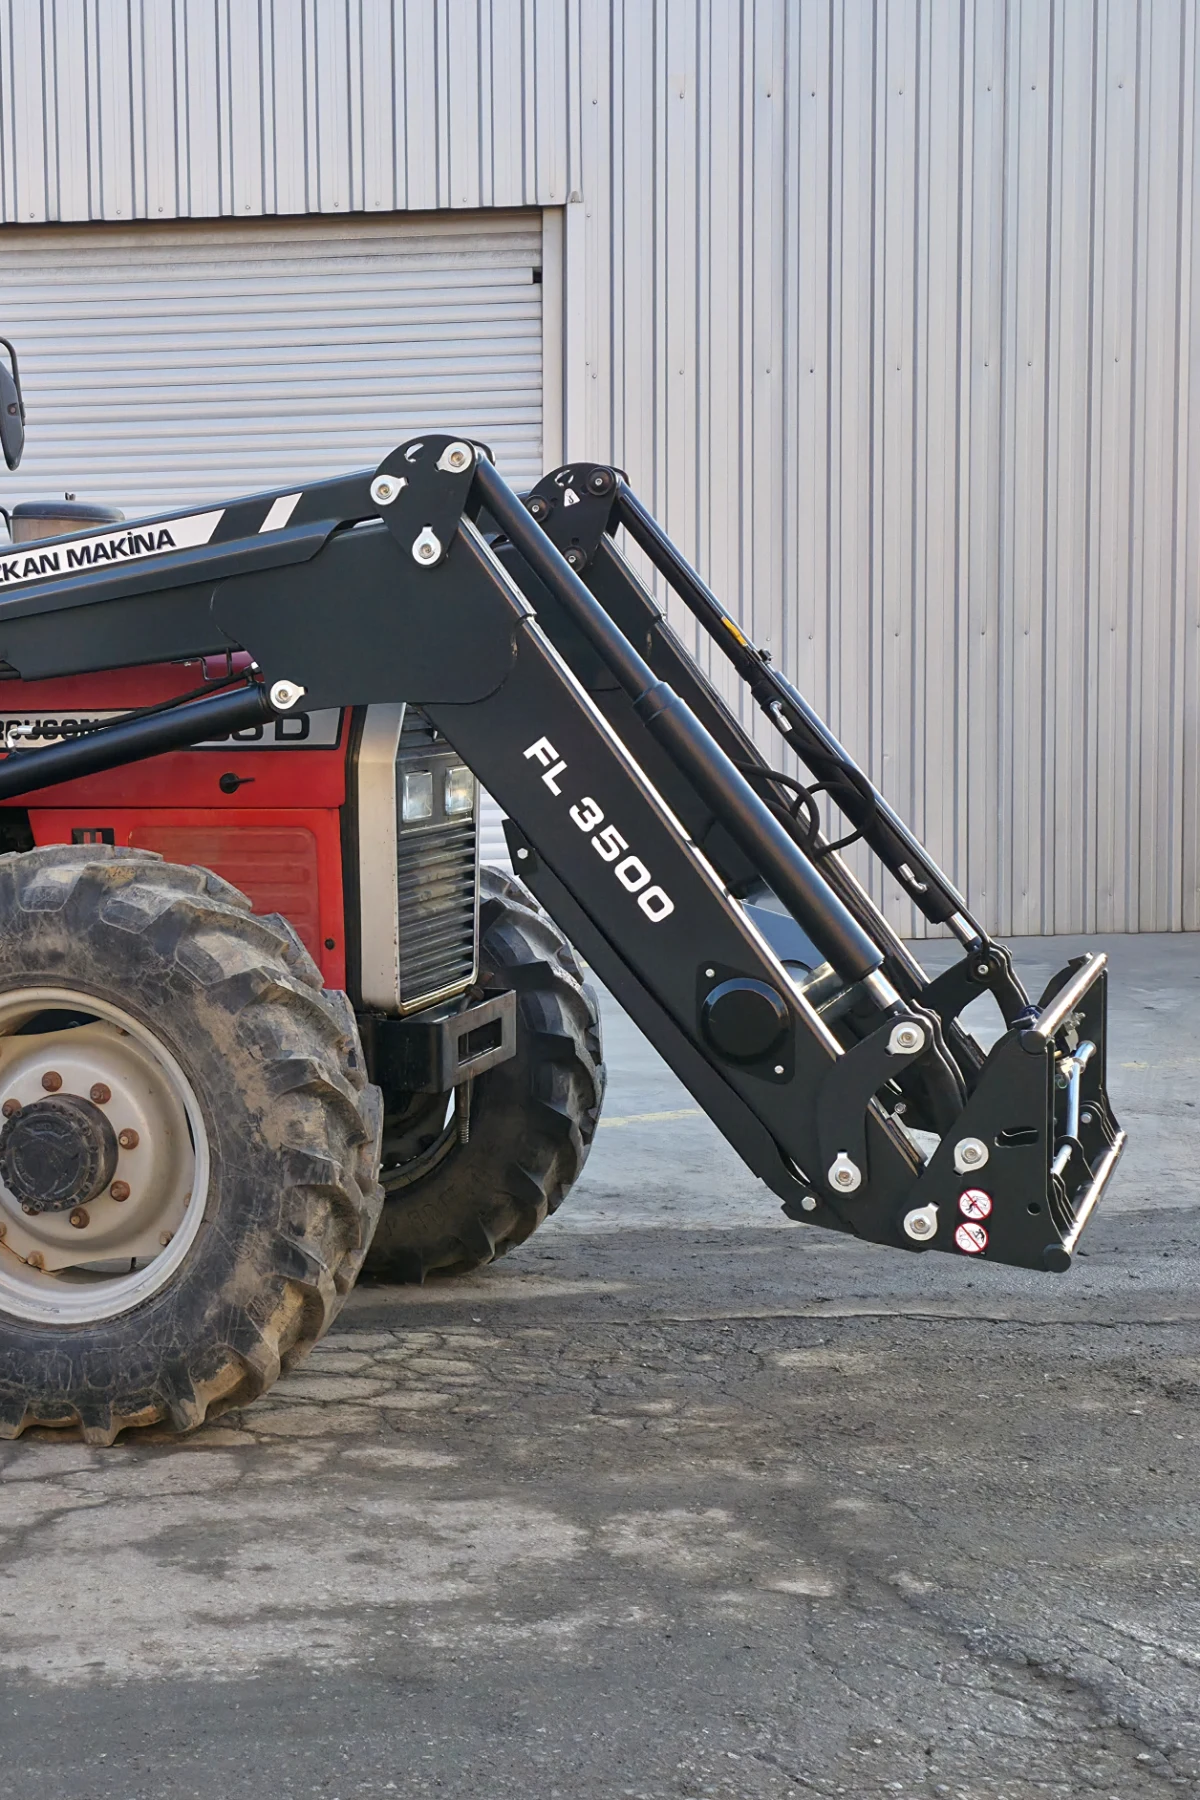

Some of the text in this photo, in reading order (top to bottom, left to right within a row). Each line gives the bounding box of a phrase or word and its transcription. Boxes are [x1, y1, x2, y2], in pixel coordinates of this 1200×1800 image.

[66, 528, 177, 568] MAKİNA
[523, 736, 675, 923] FL 3500
